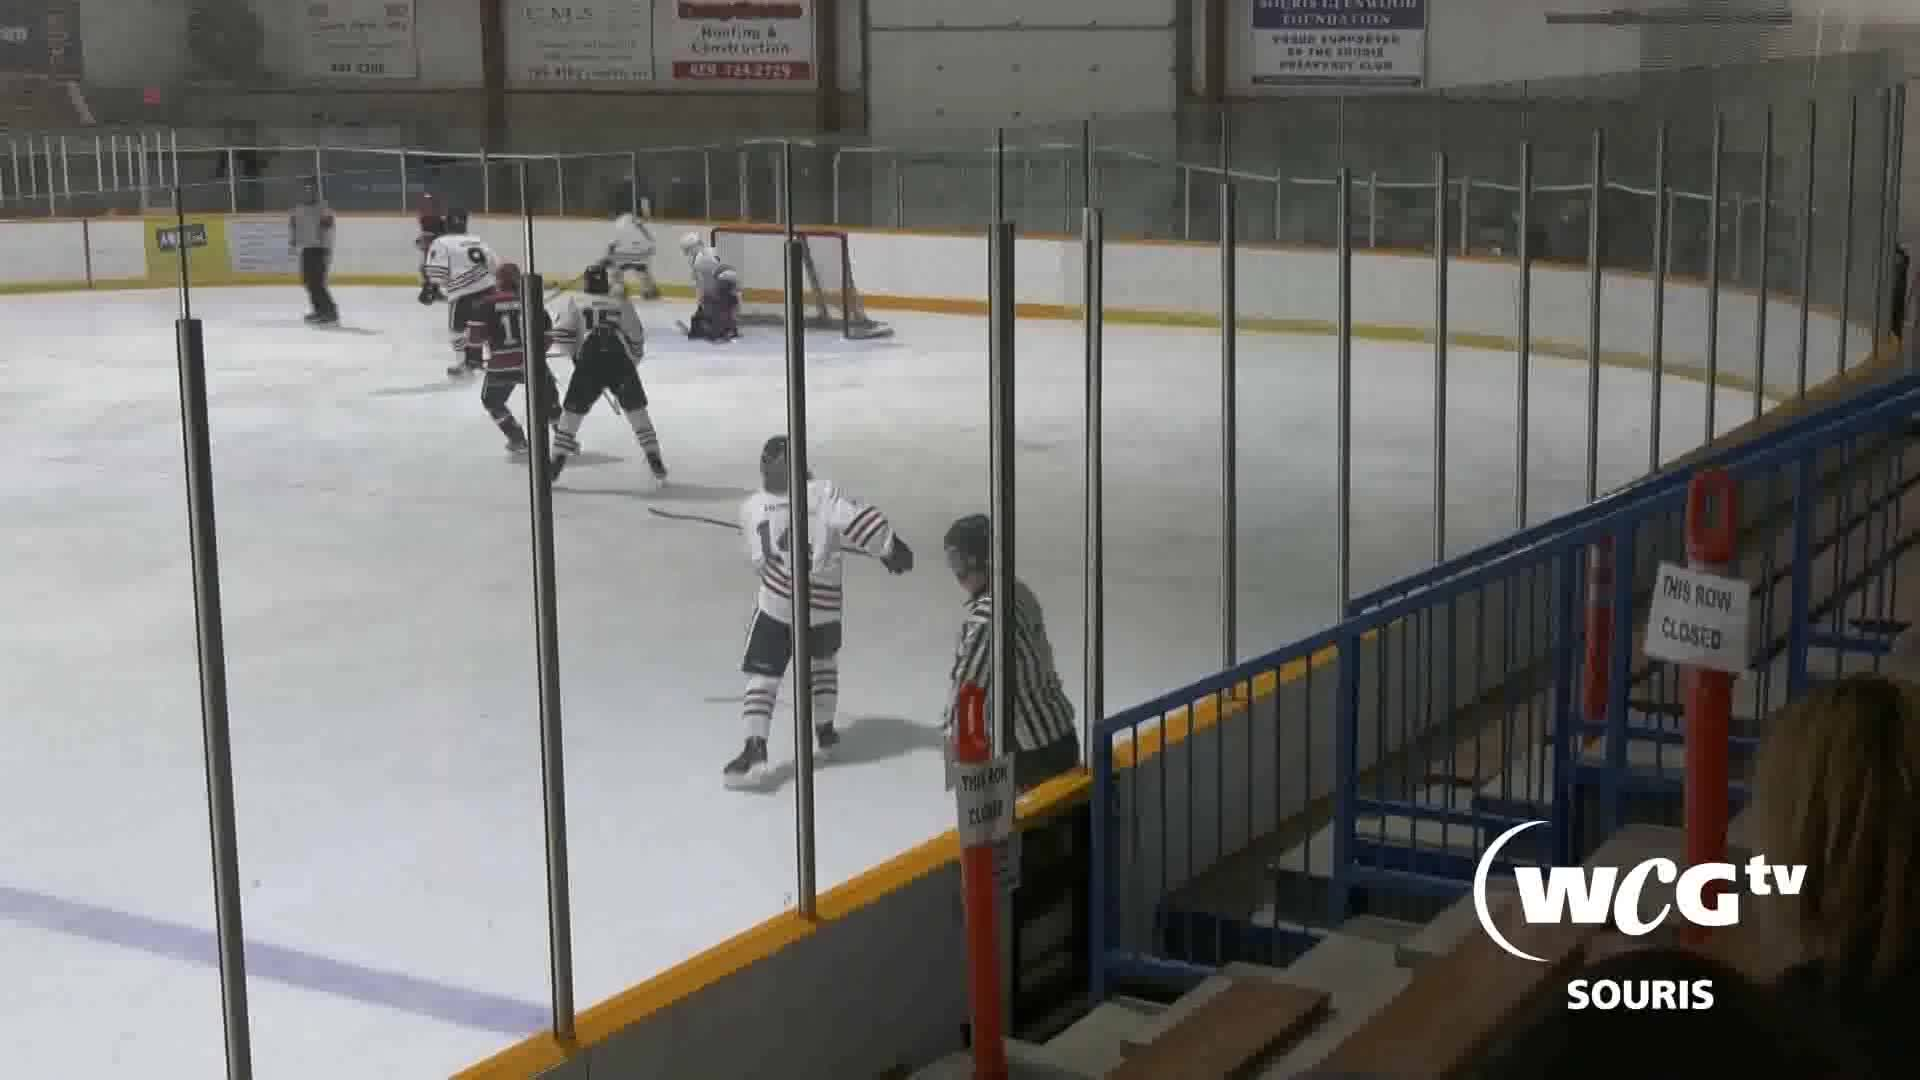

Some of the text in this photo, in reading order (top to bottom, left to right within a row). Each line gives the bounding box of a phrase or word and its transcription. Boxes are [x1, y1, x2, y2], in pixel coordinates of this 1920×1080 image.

[1280, 15, 1392, 24] FOUNDATION
[767, 25, 777, 37] &
[689, 41, 790, 56] Construction
[467, 246, 486, 265] 9
[583, 307, 621, 334] 15
[1663, 576, 1732, 613] THIS ROW
[1662, 616, 1721, 650] CLOSED
